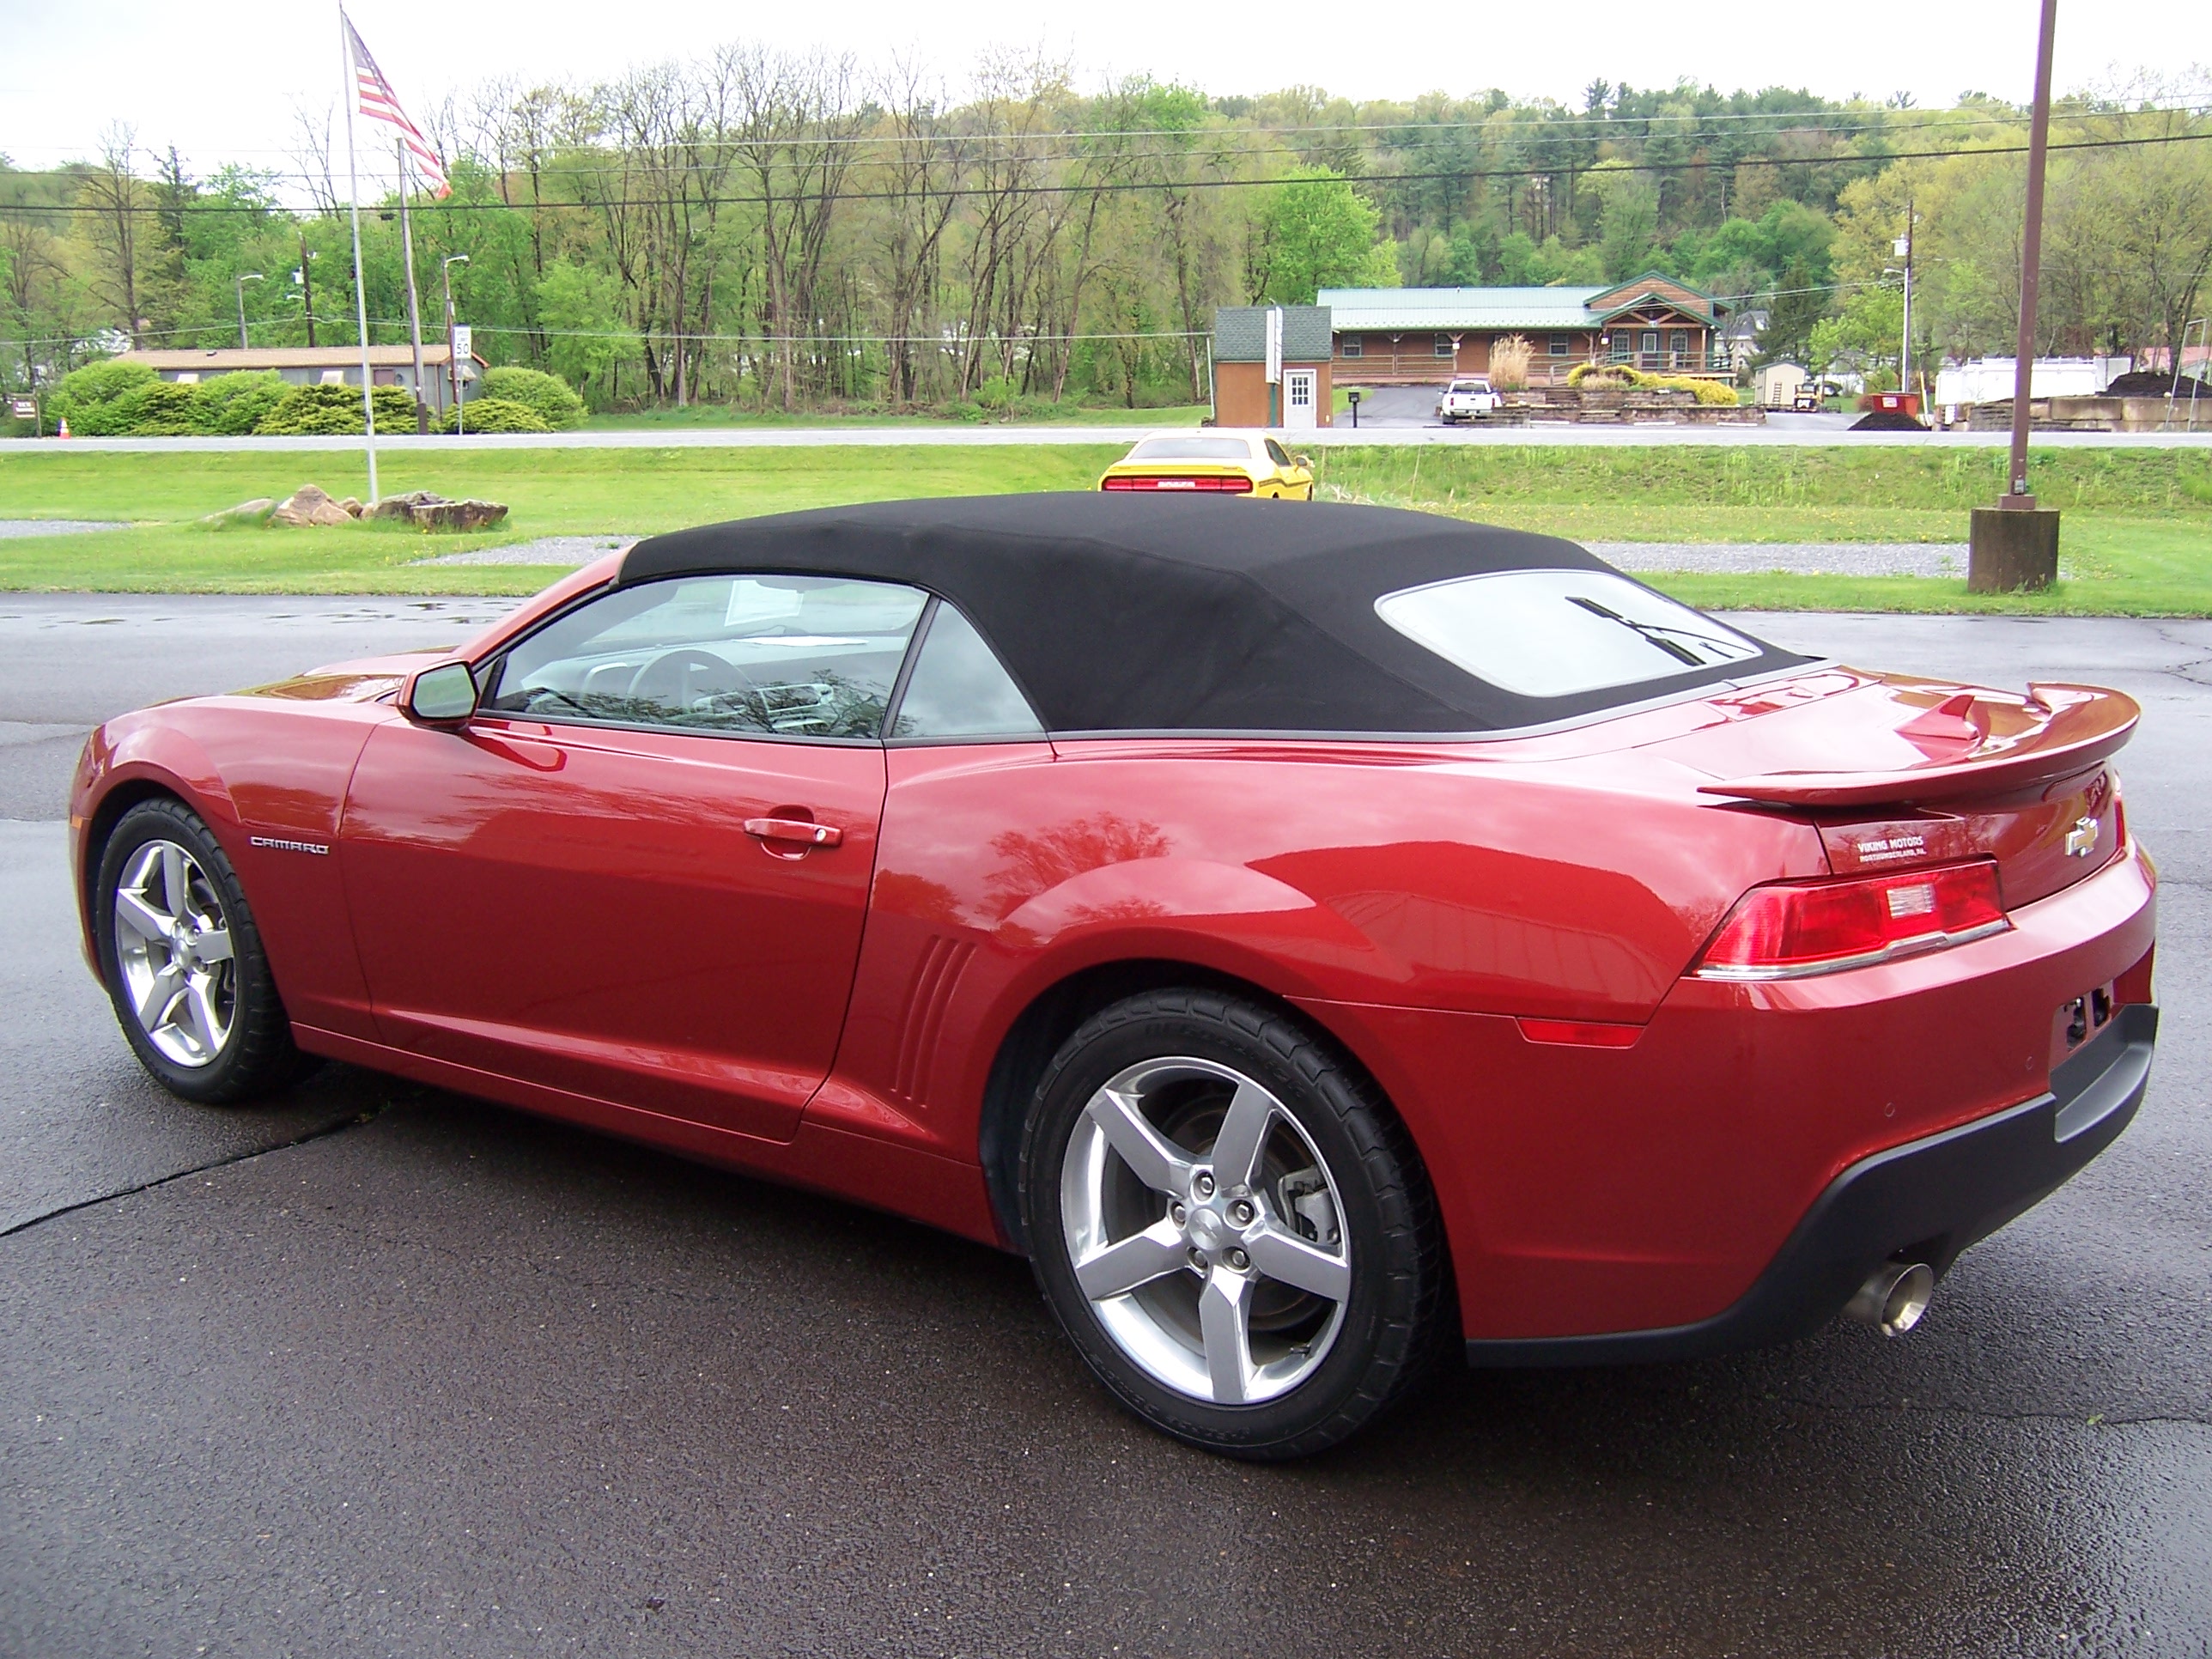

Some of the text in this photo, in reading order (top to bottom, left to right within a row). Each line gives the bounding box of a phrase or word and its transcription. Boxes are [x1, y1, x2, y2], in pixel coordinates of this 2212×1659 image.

[456, 343, 470, 354] 50
[250, 836, 330, 854] CAMARO
[1857, 836, 1924, 853] VIKING MOTORS
